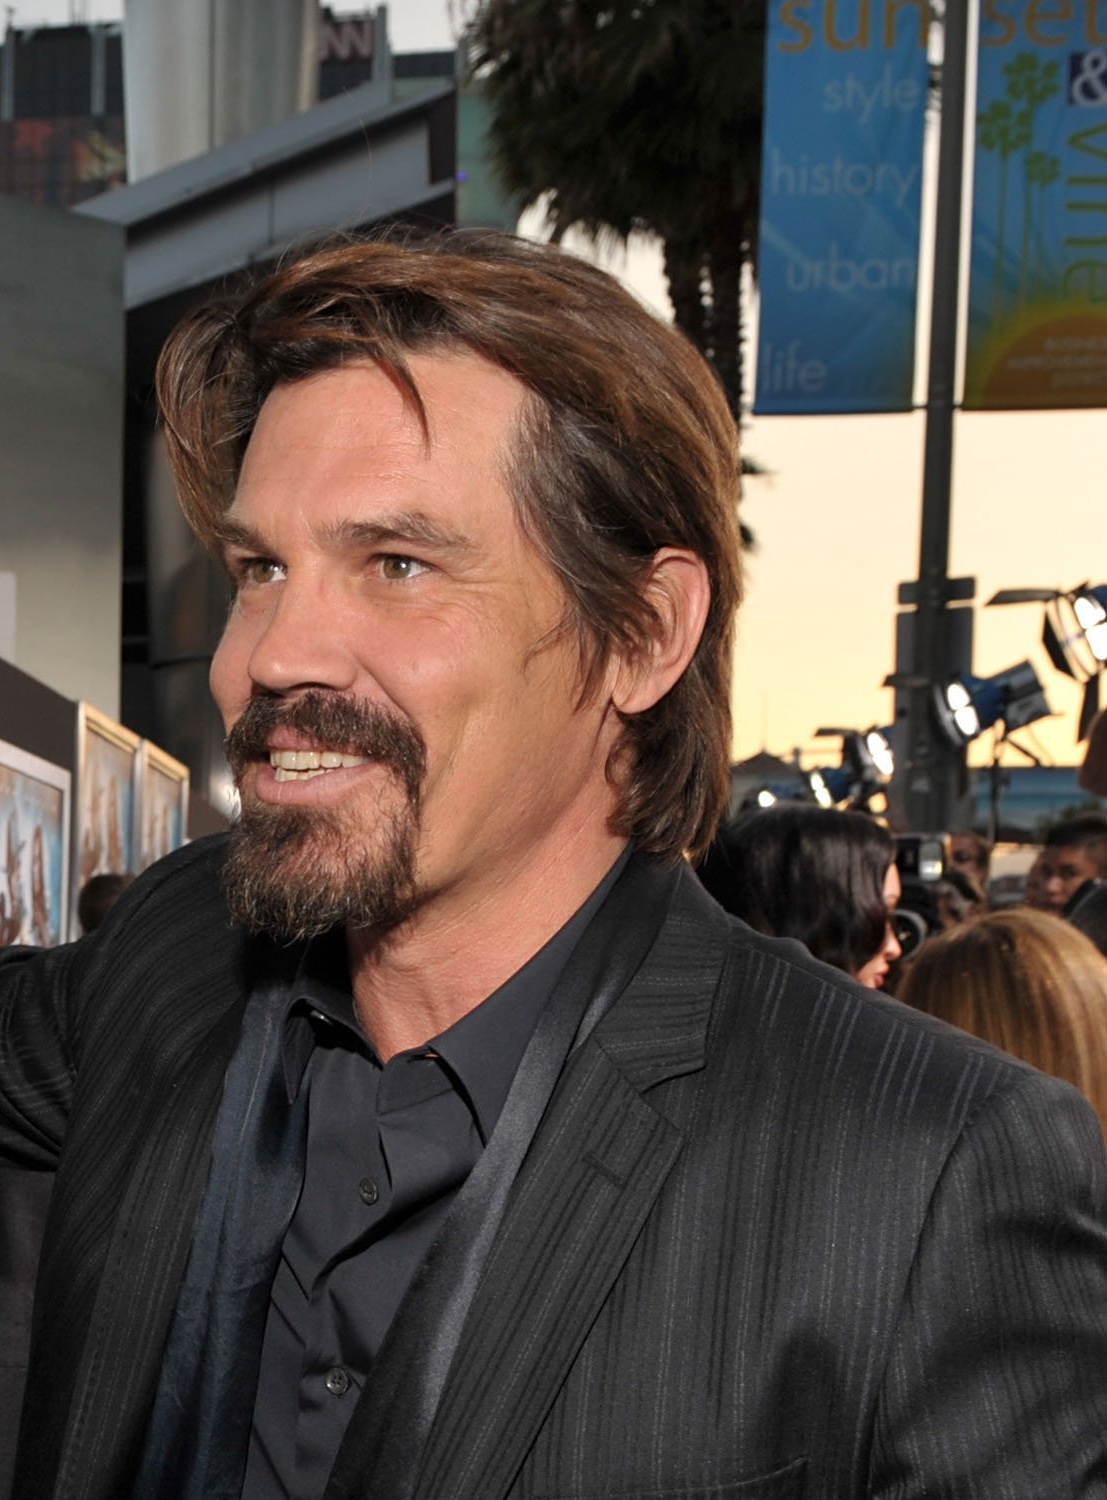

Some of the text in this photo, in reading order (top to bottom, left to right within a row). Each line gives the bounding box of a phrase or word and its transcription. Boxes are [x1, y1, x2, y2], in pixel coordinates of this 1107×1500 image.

[779, 0, 931, 53] sun
[823, 60, 921, 127] style
[770, 146, 919, 210] history
[786, 239, 915, 291] urban
[761, 339, 828, 392] life
